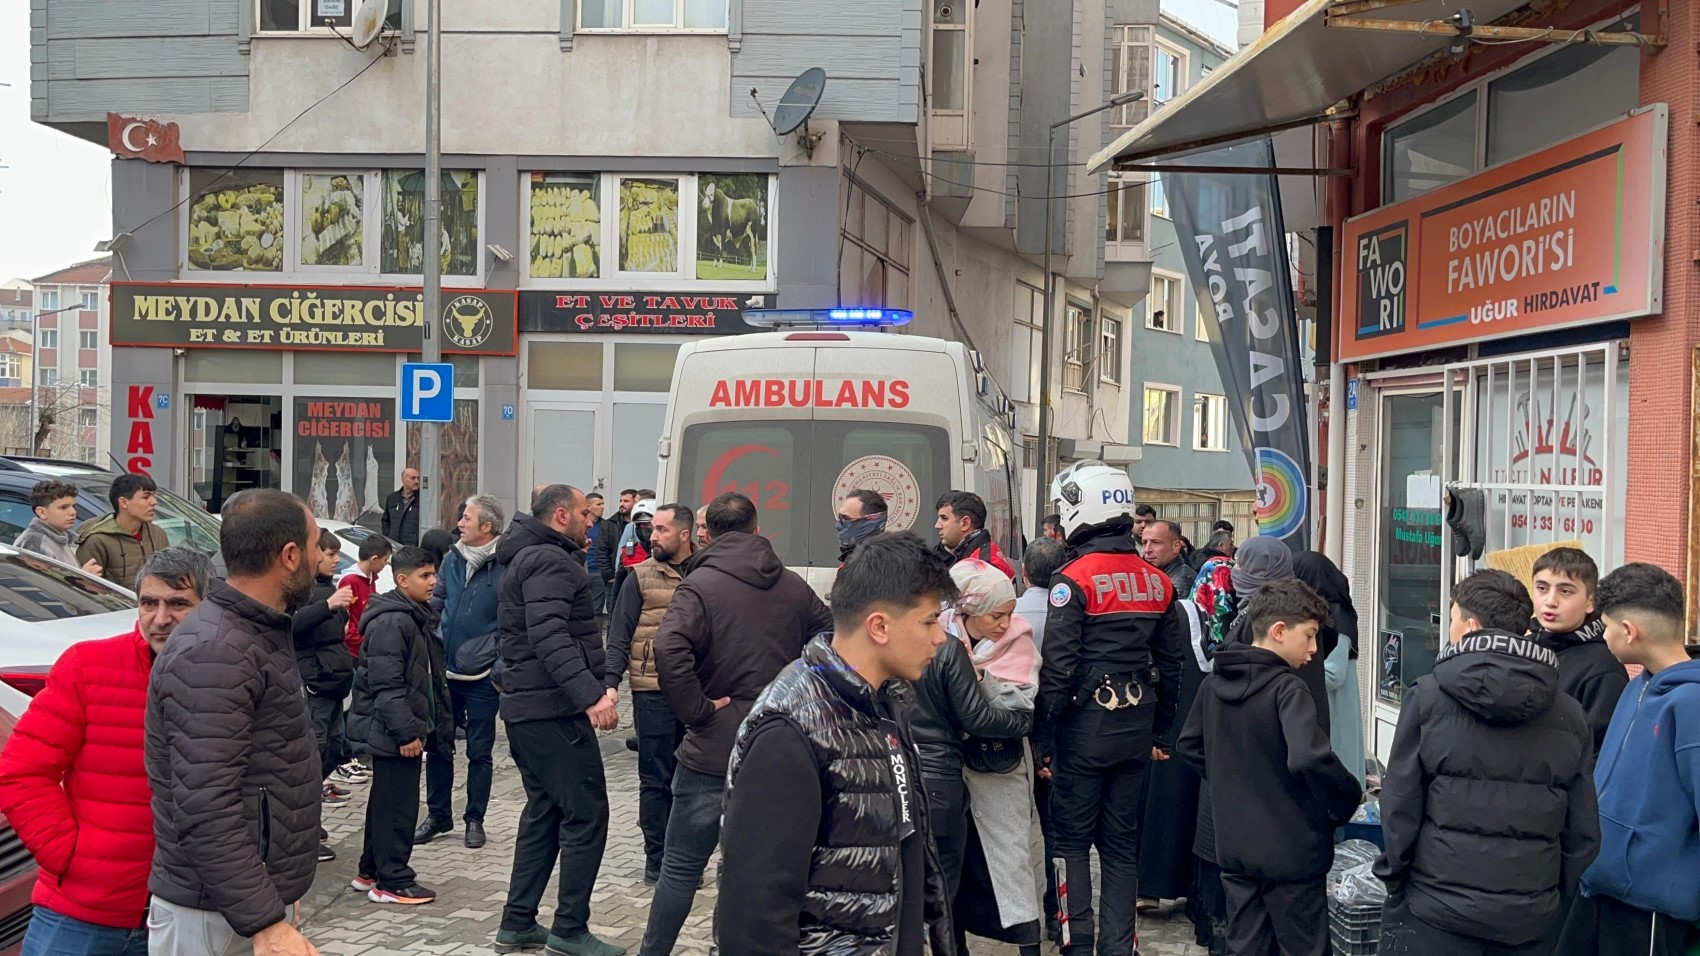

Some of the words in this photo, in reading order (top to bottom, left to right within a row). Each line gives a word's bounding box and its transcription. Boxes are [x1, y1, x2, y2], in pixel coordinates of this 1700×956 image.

[1450, 190, 1575, 252] BOYACILARIN
[1359, 235, 1381, 270] FA
[1448, 228, 1574, 294] FAWORİ'Sİ
[1370, 261, 1404, 299] WO
[133, 295, 261, 322] MEYDAN
[269, 291, 424, 326] CİĞERCİSİ
[453, 298, 483, 308] KASAP
[556, 295, 590, 308] ET
[599, 296, 636, 309] VE
[643, 296, 738, 310] TAVUK
[1380, 296, 1398, 331] RI
[1471, 298, 1518, 325] UĞUR
[1524, 282, 1600, 314] HIRDAVAT
[189, 328, 217, 342] ET
[222, 329, 241, 342] &
[247, 330, 273, 343] ET
[279, 327, 384, 345] ÜRÜNLERİ
[575, 311, 716, 330] ÇEŞİTLERİ
[453, 335, 482, 345] KASAP
[158, 395, 168, 404] 7C
[413, 369, 441, 415] P
[709, 379, 910, 408] AMBULANS
[307, 402, 381, 418] MEYDAN
[298, 419, 390, 437] CİĞERCİSİ
[1102, 489, 1135, 504] POLİ
[1092, 567, 1165, 604] POLİS
[890, 754, 911, 823] MONCLER
